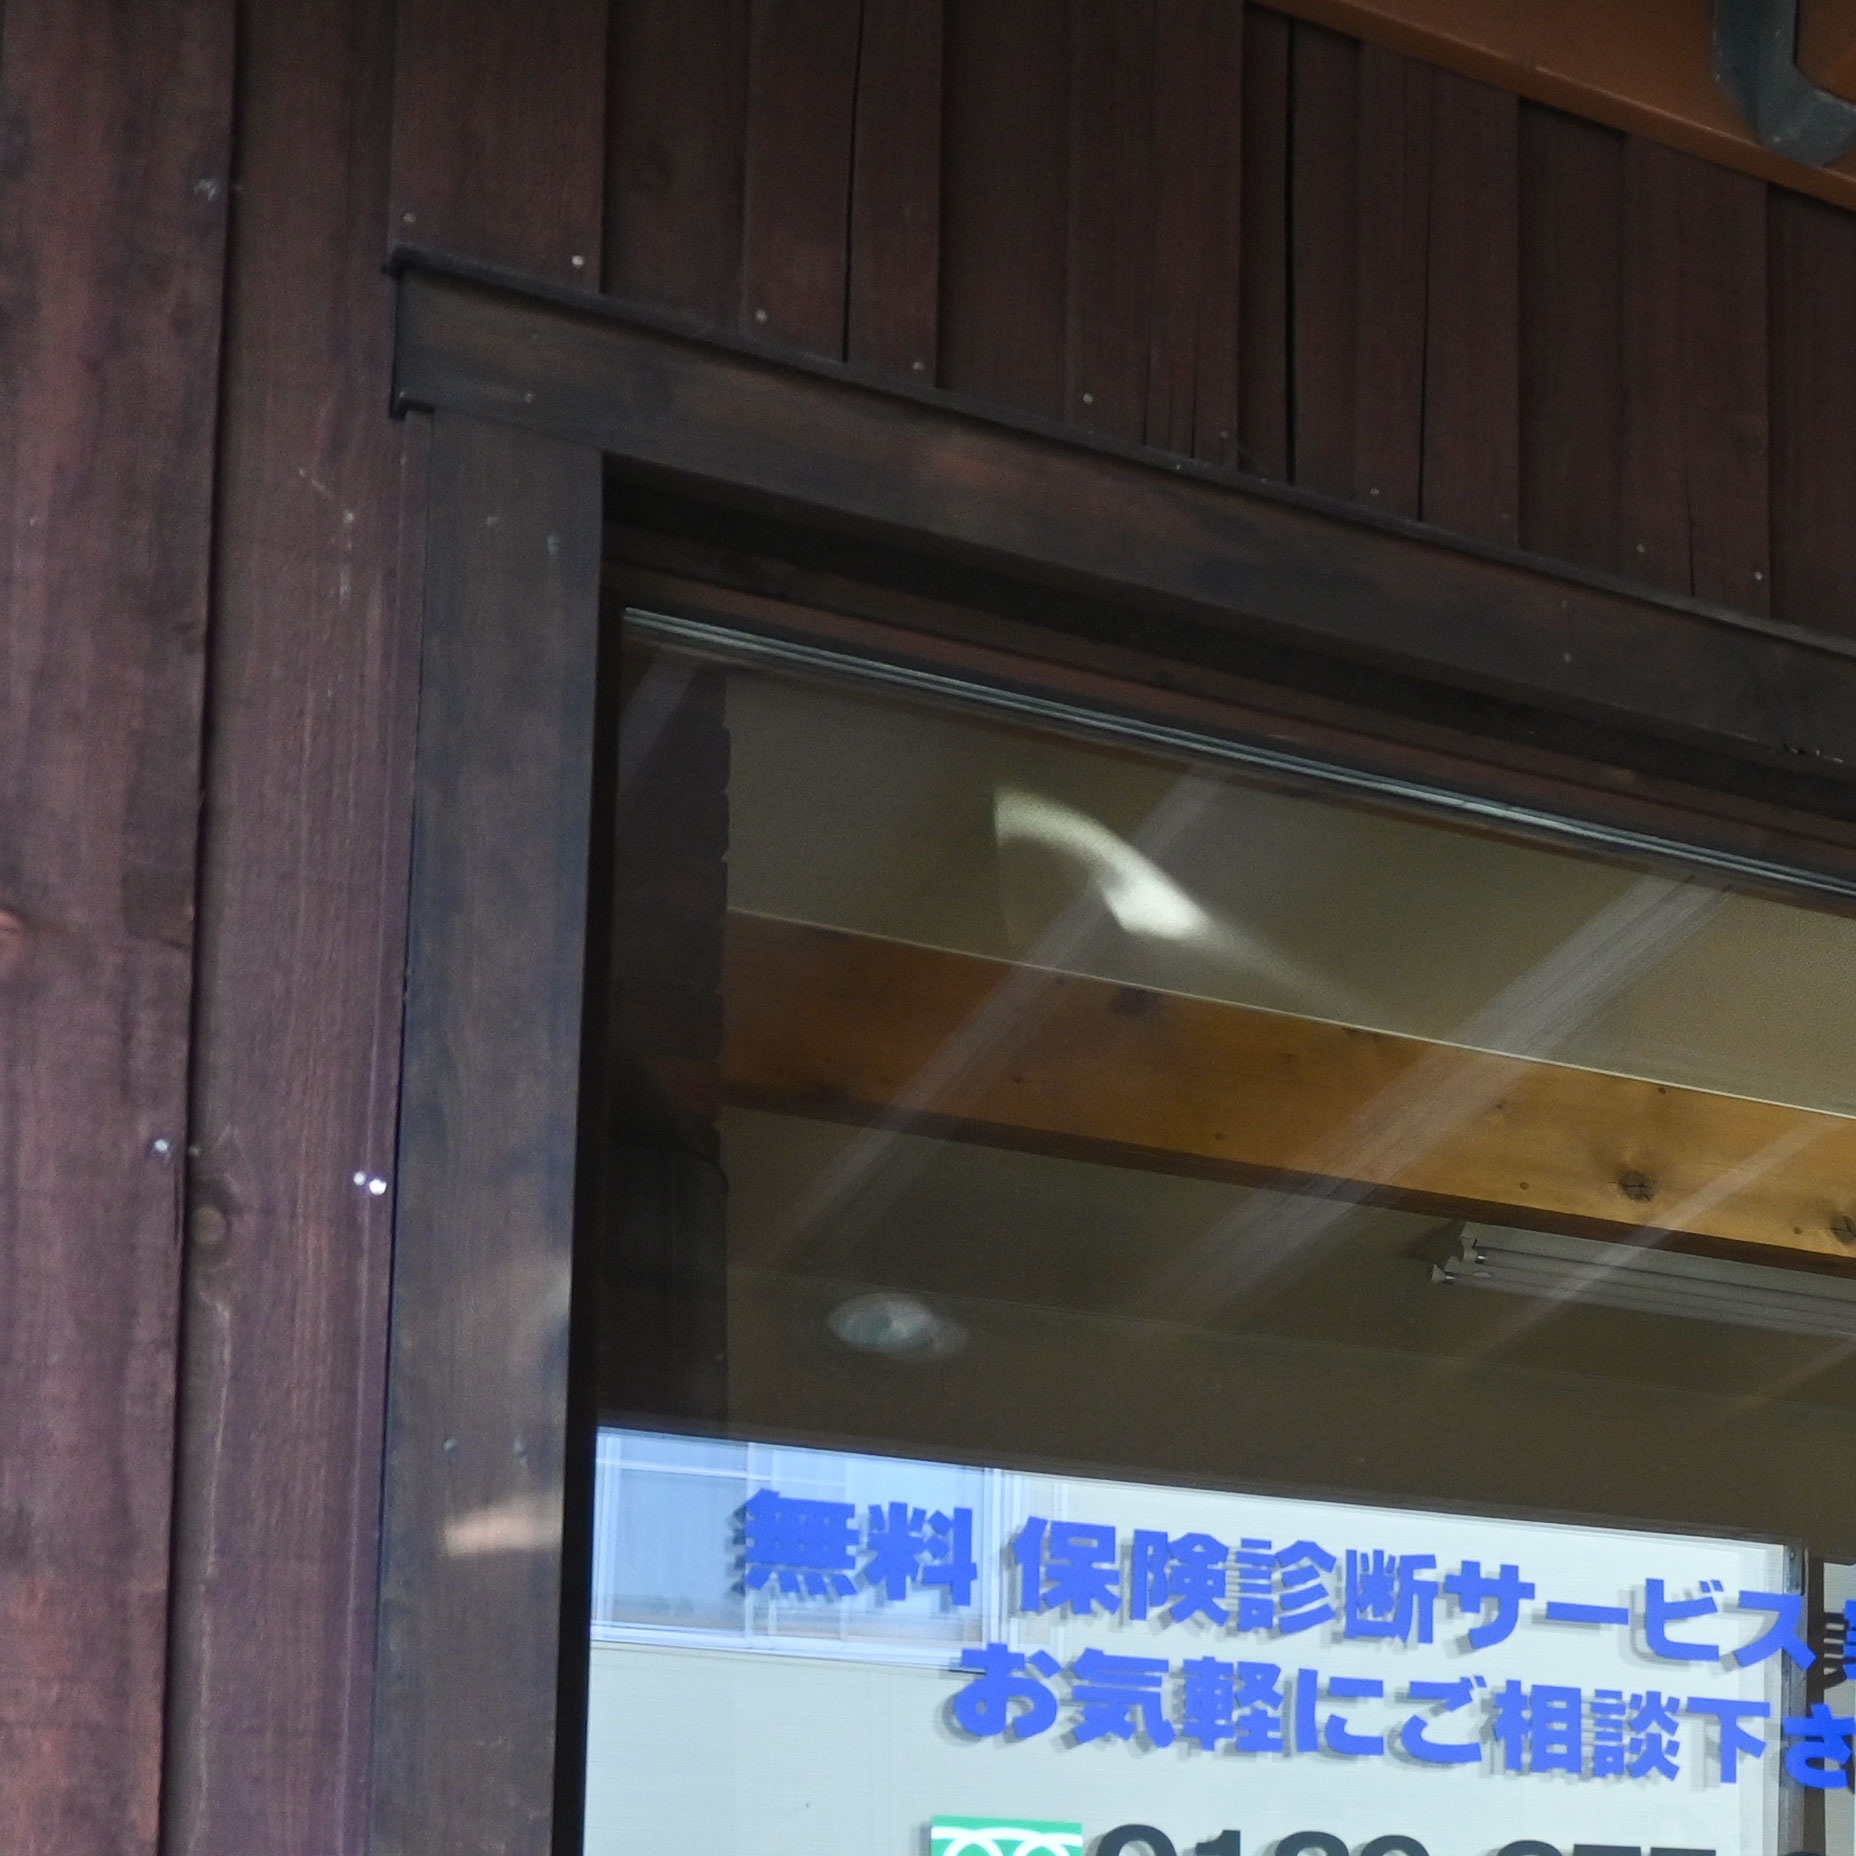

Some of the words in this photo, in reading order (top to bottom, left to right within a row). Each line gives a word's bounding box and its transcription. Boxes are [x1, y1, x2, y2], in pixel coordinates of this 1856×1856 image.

[744, 1489, 977, 1606] 無料
[1014, 1516, 1817, 1671] 保険診断サービス
